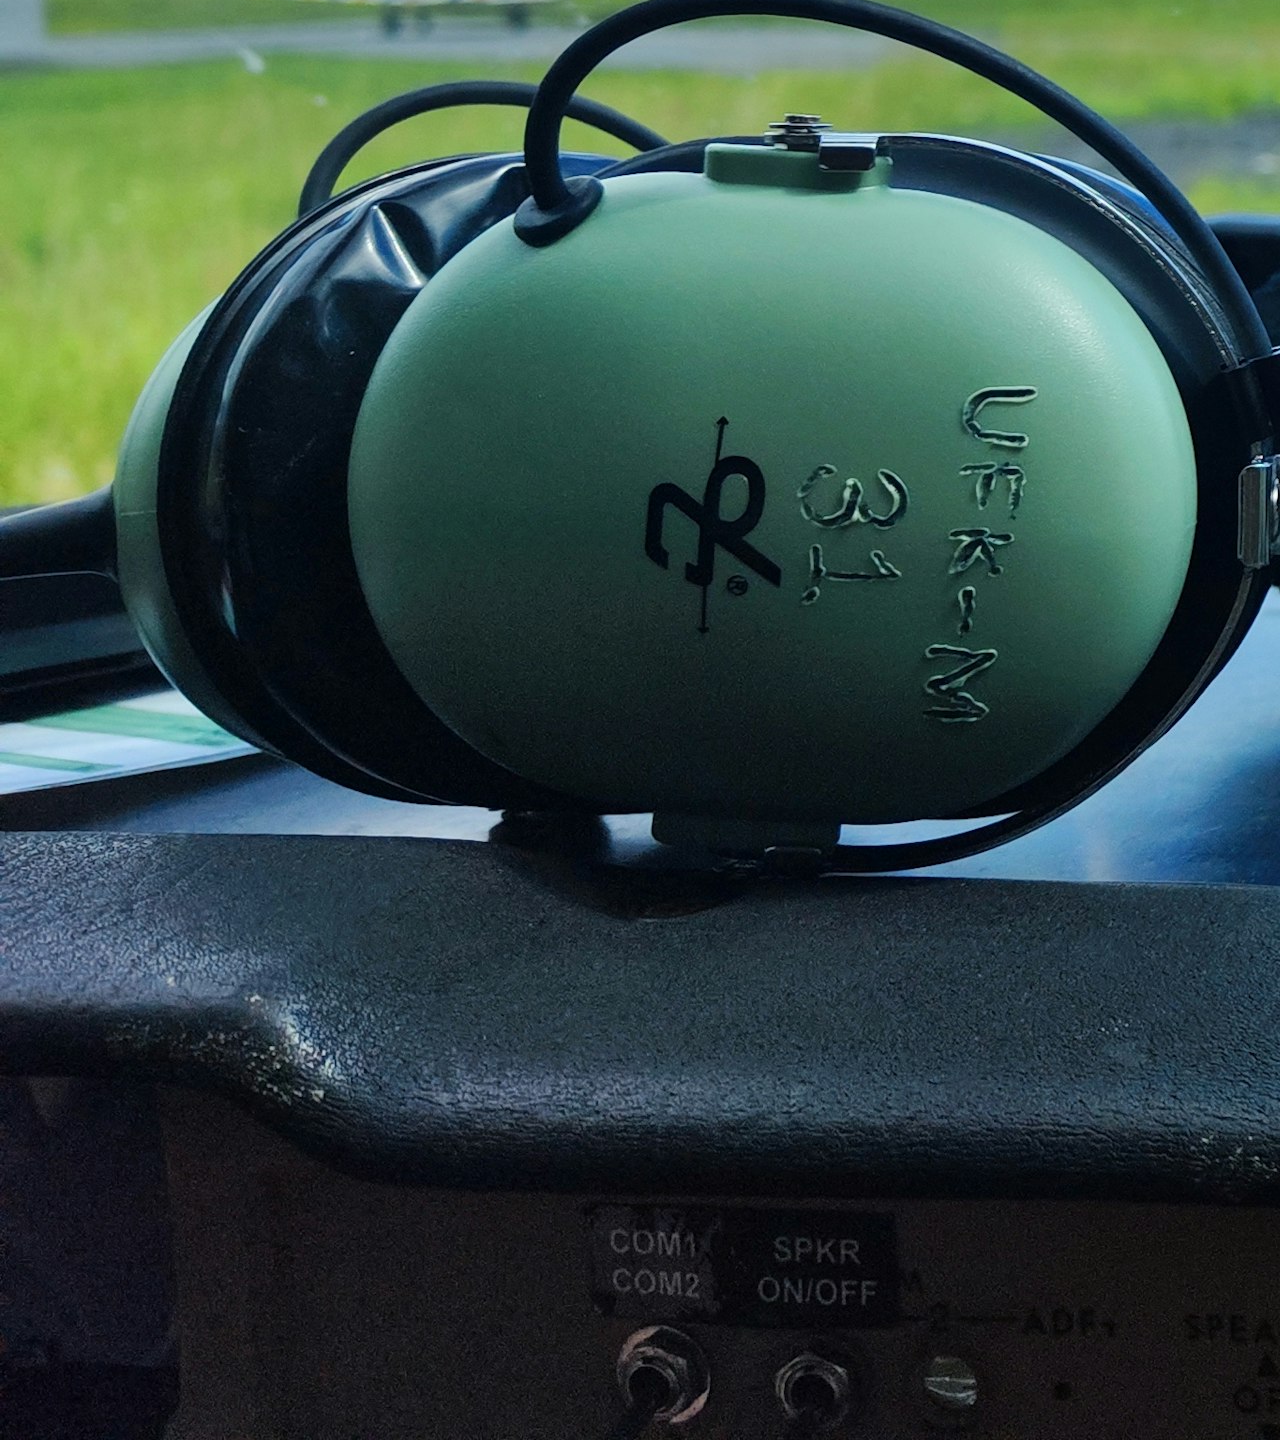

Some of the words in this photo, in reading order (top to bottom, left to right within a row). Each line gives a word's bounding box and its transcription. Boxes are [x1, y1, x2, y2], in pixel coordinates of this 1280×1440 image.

[922, 384, 1039, 723] UFK-M
[609, 1227, 697, 1258] COM1
[773, 1236, 861, 1266] SPKR
[611, 1268, 700, 1299] COM2
[757, 1275, 878, 1307] ON/OFF
